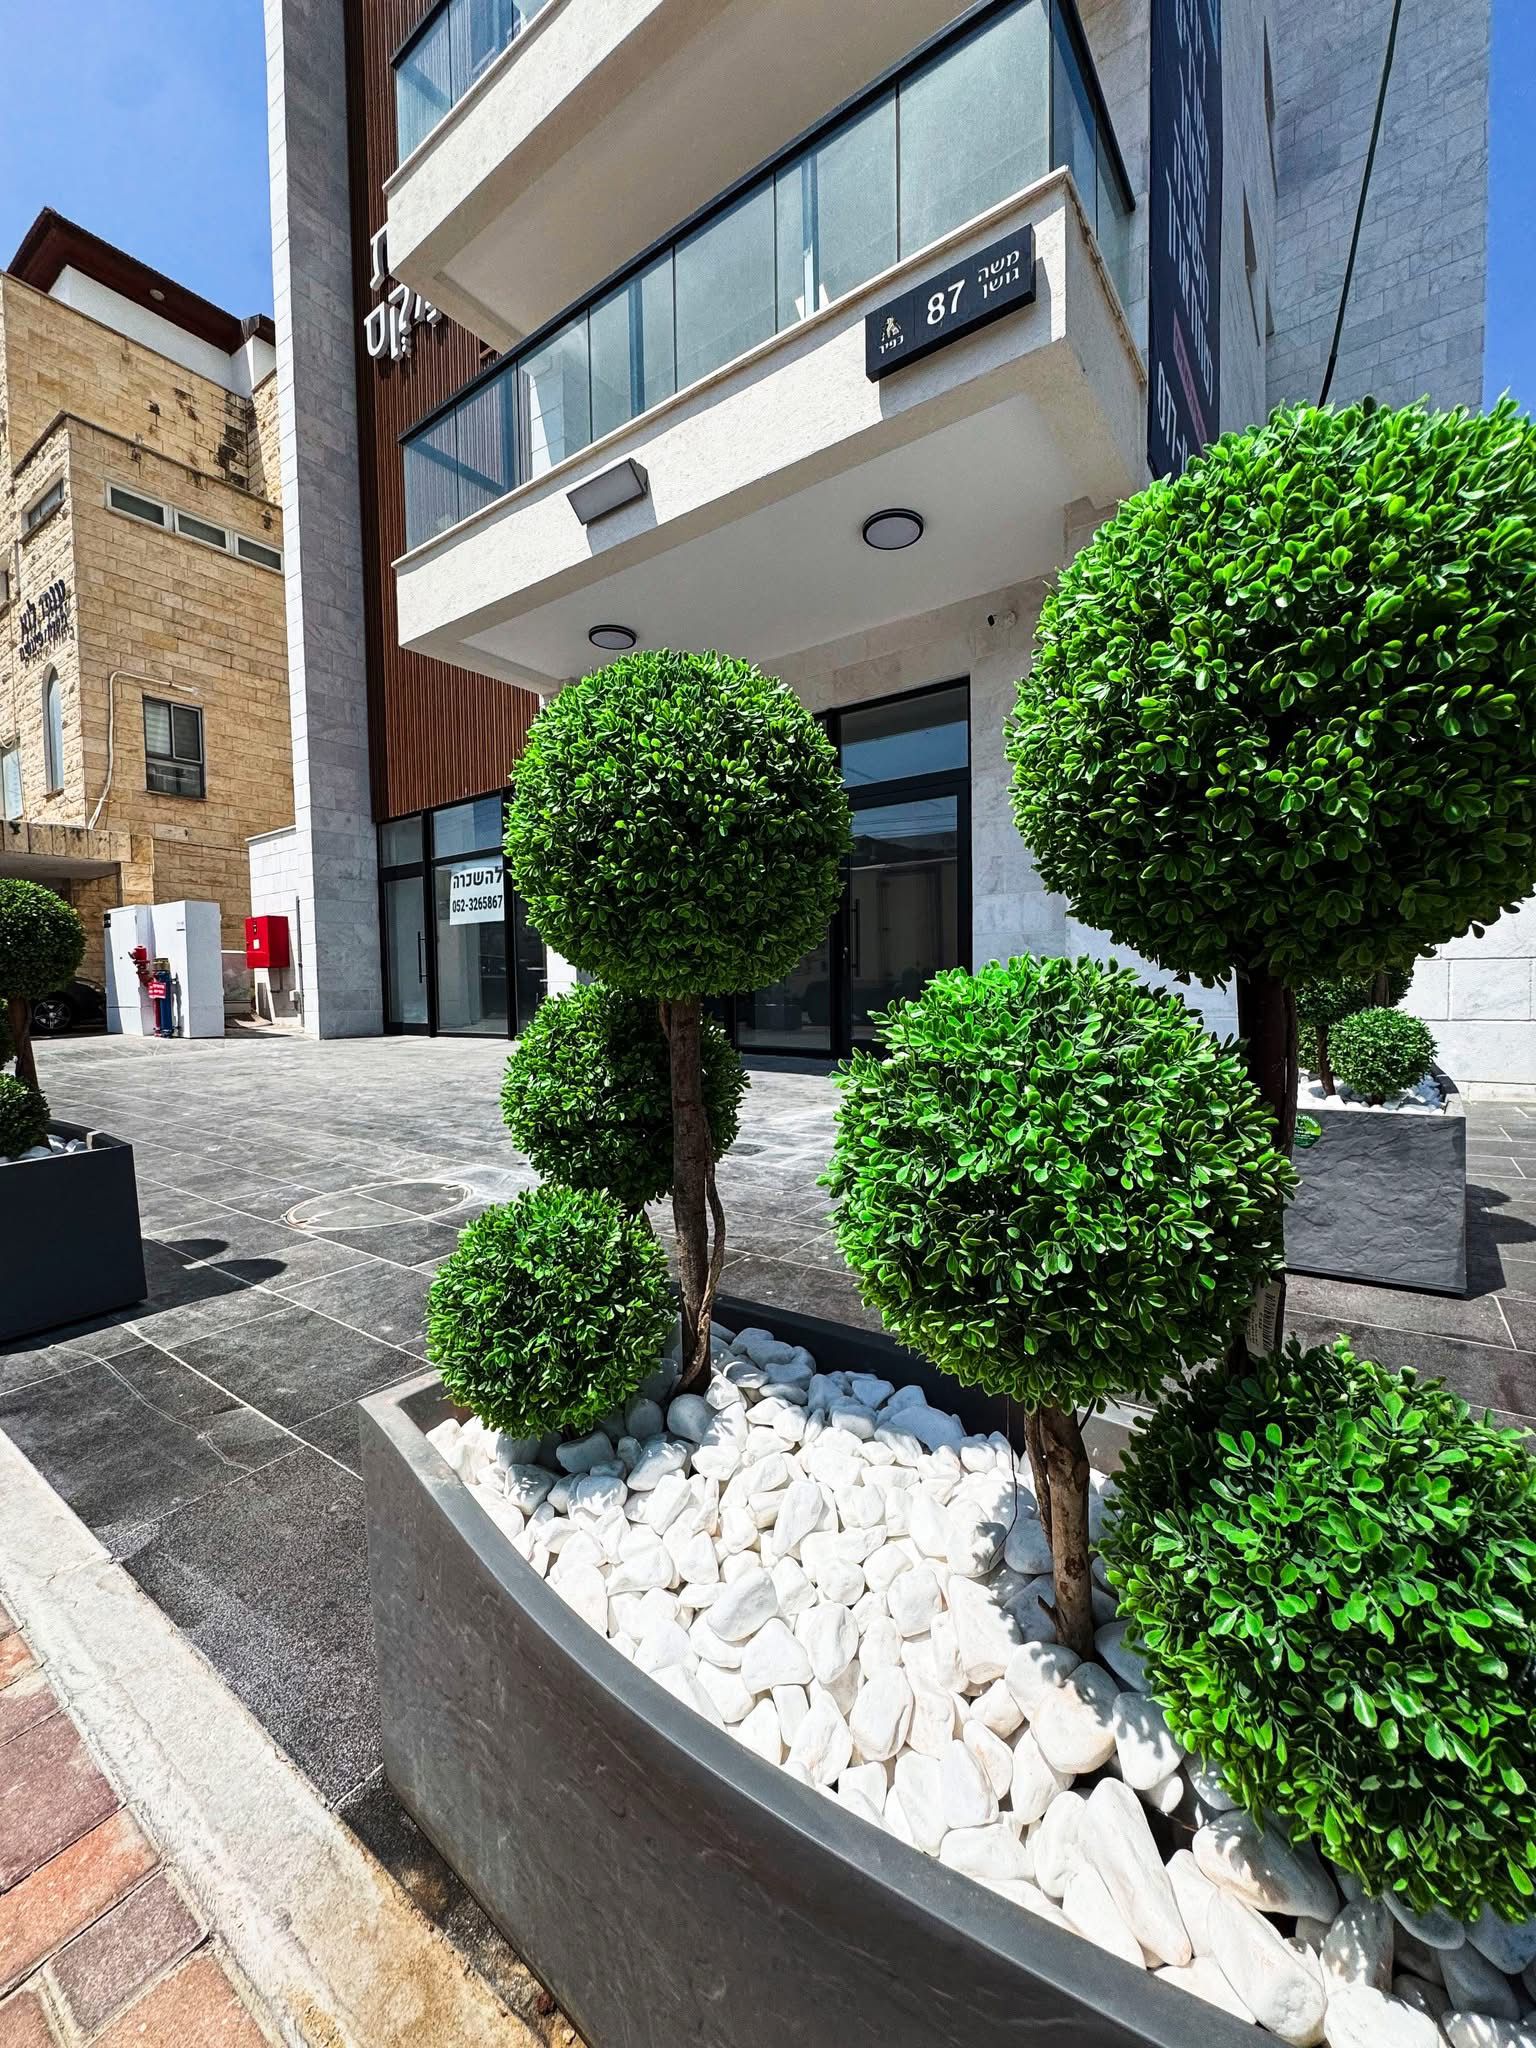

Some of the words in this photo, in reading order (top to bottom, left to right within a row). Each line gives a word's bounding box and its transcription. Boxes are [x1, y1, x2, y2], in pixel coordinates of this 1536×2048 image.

[1178, 63, 1207, 246] ומסחר
[1173, 118, 1209, 324] להשכרה
[1165, 166, 1190, 320] ארוך
[978, 250, 1020, 282] משה
[983, 267, 1020, 298] גושן
[927, 279, 966, 325] 87
[879, 334, 904, 354] כפיר
[453, 866, 503, 889] להשכרה
[452, 895, 503, 913] 052-3265867
